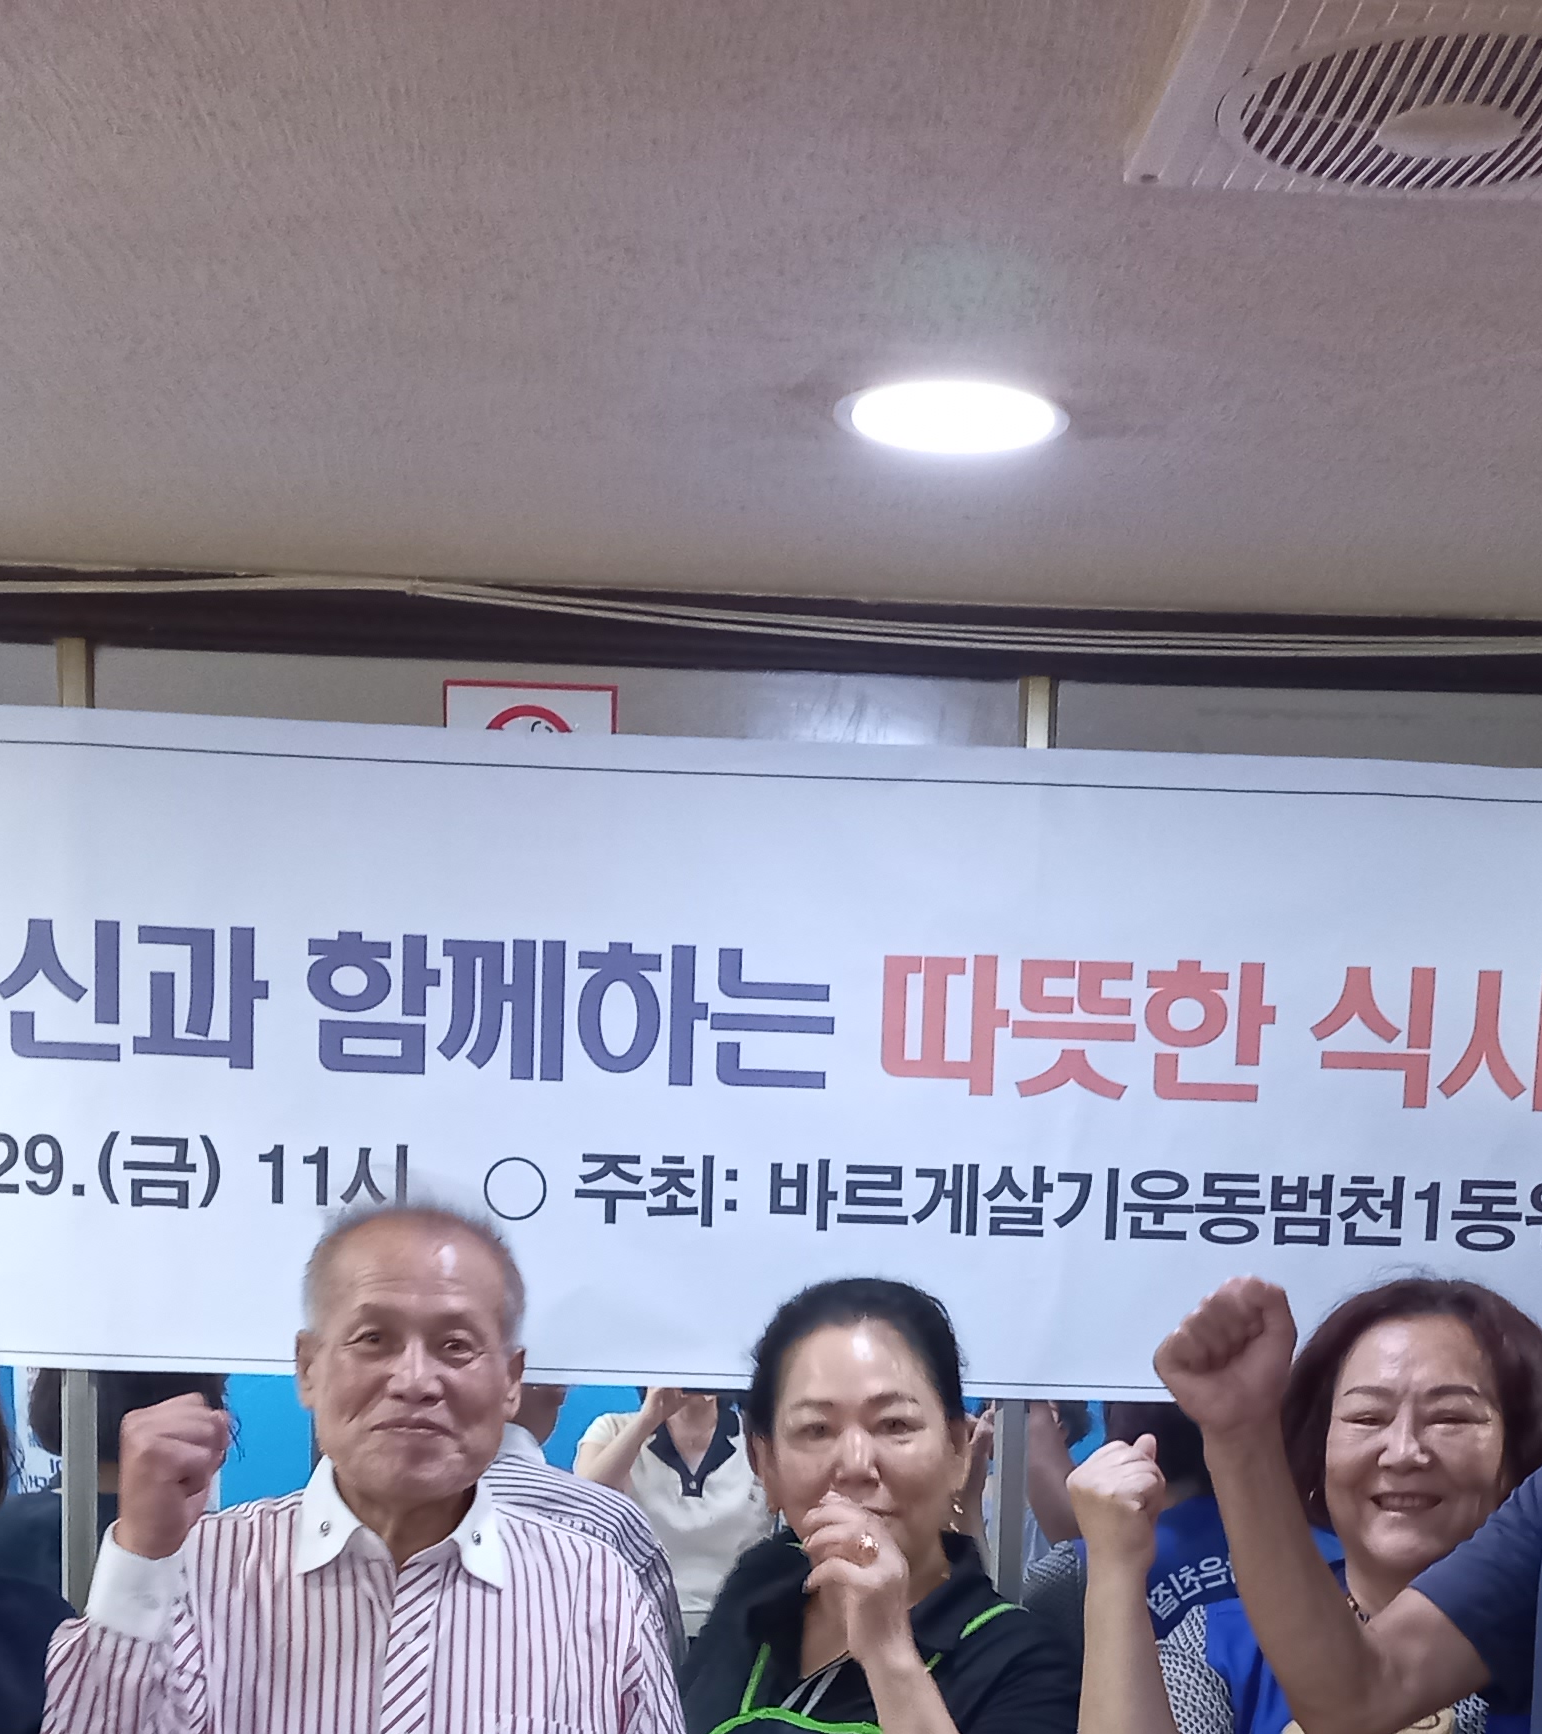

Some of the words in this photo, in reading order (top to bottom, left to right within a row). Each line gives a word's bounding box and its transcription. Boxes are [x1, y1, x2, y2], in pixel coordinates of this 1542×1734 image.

[305, 929, 833, 1090] 함께하는
[880, 954, 1276, 1103] 따뜻한
[258, 1143, 409, 1206] 11시
[574, 1153, 738, 1228] 주최:
